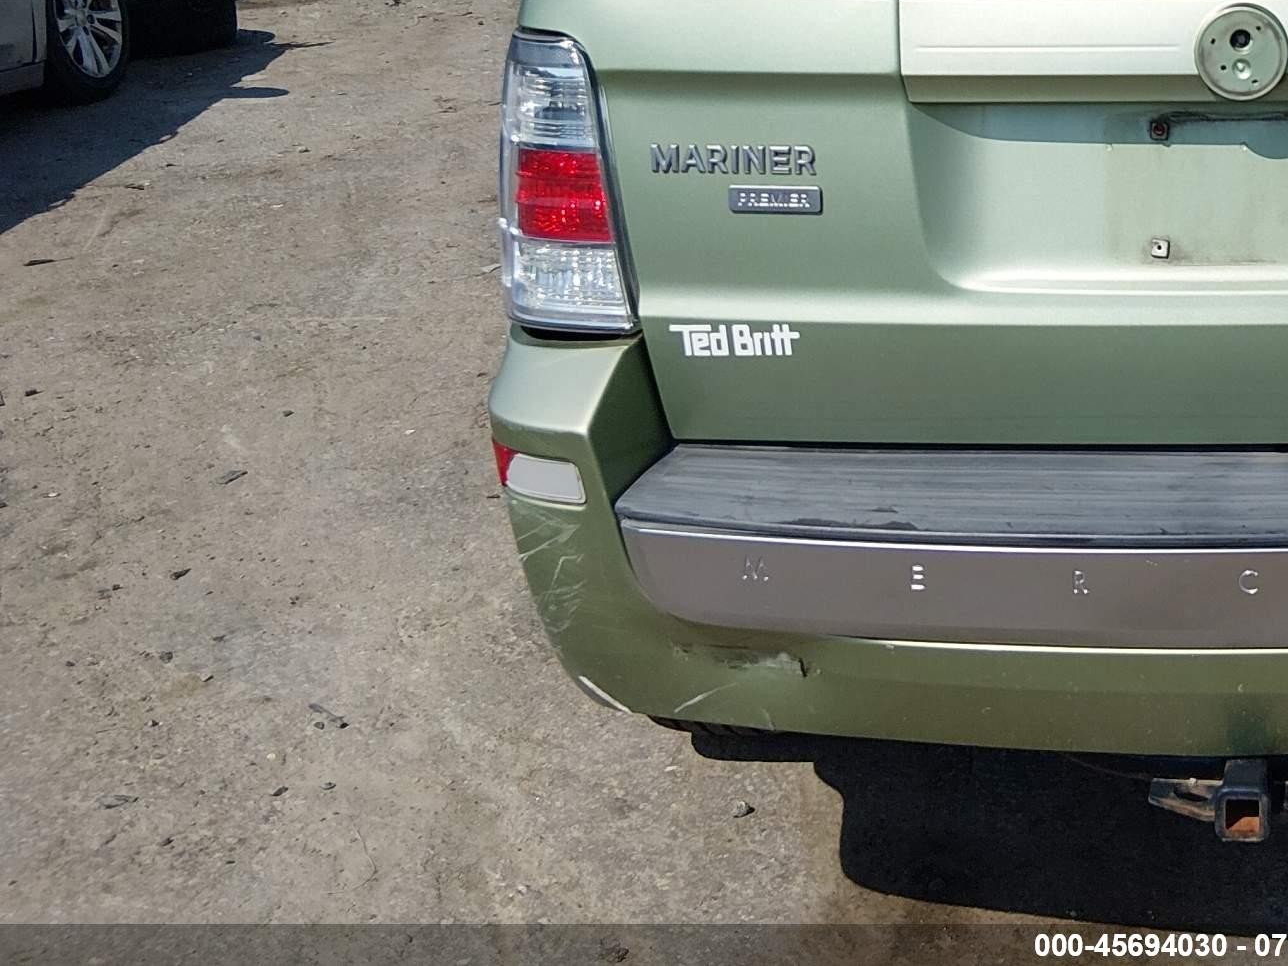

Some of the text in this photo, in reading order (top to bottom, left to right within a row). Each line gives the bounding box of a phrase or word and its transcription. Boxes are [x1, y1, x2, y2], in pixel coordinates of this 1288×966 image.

[650, 143, 817, 175] MARINER
[737, 192, 811, 209] PREMIER
[669, 324, 800, 356] Ted Britt
